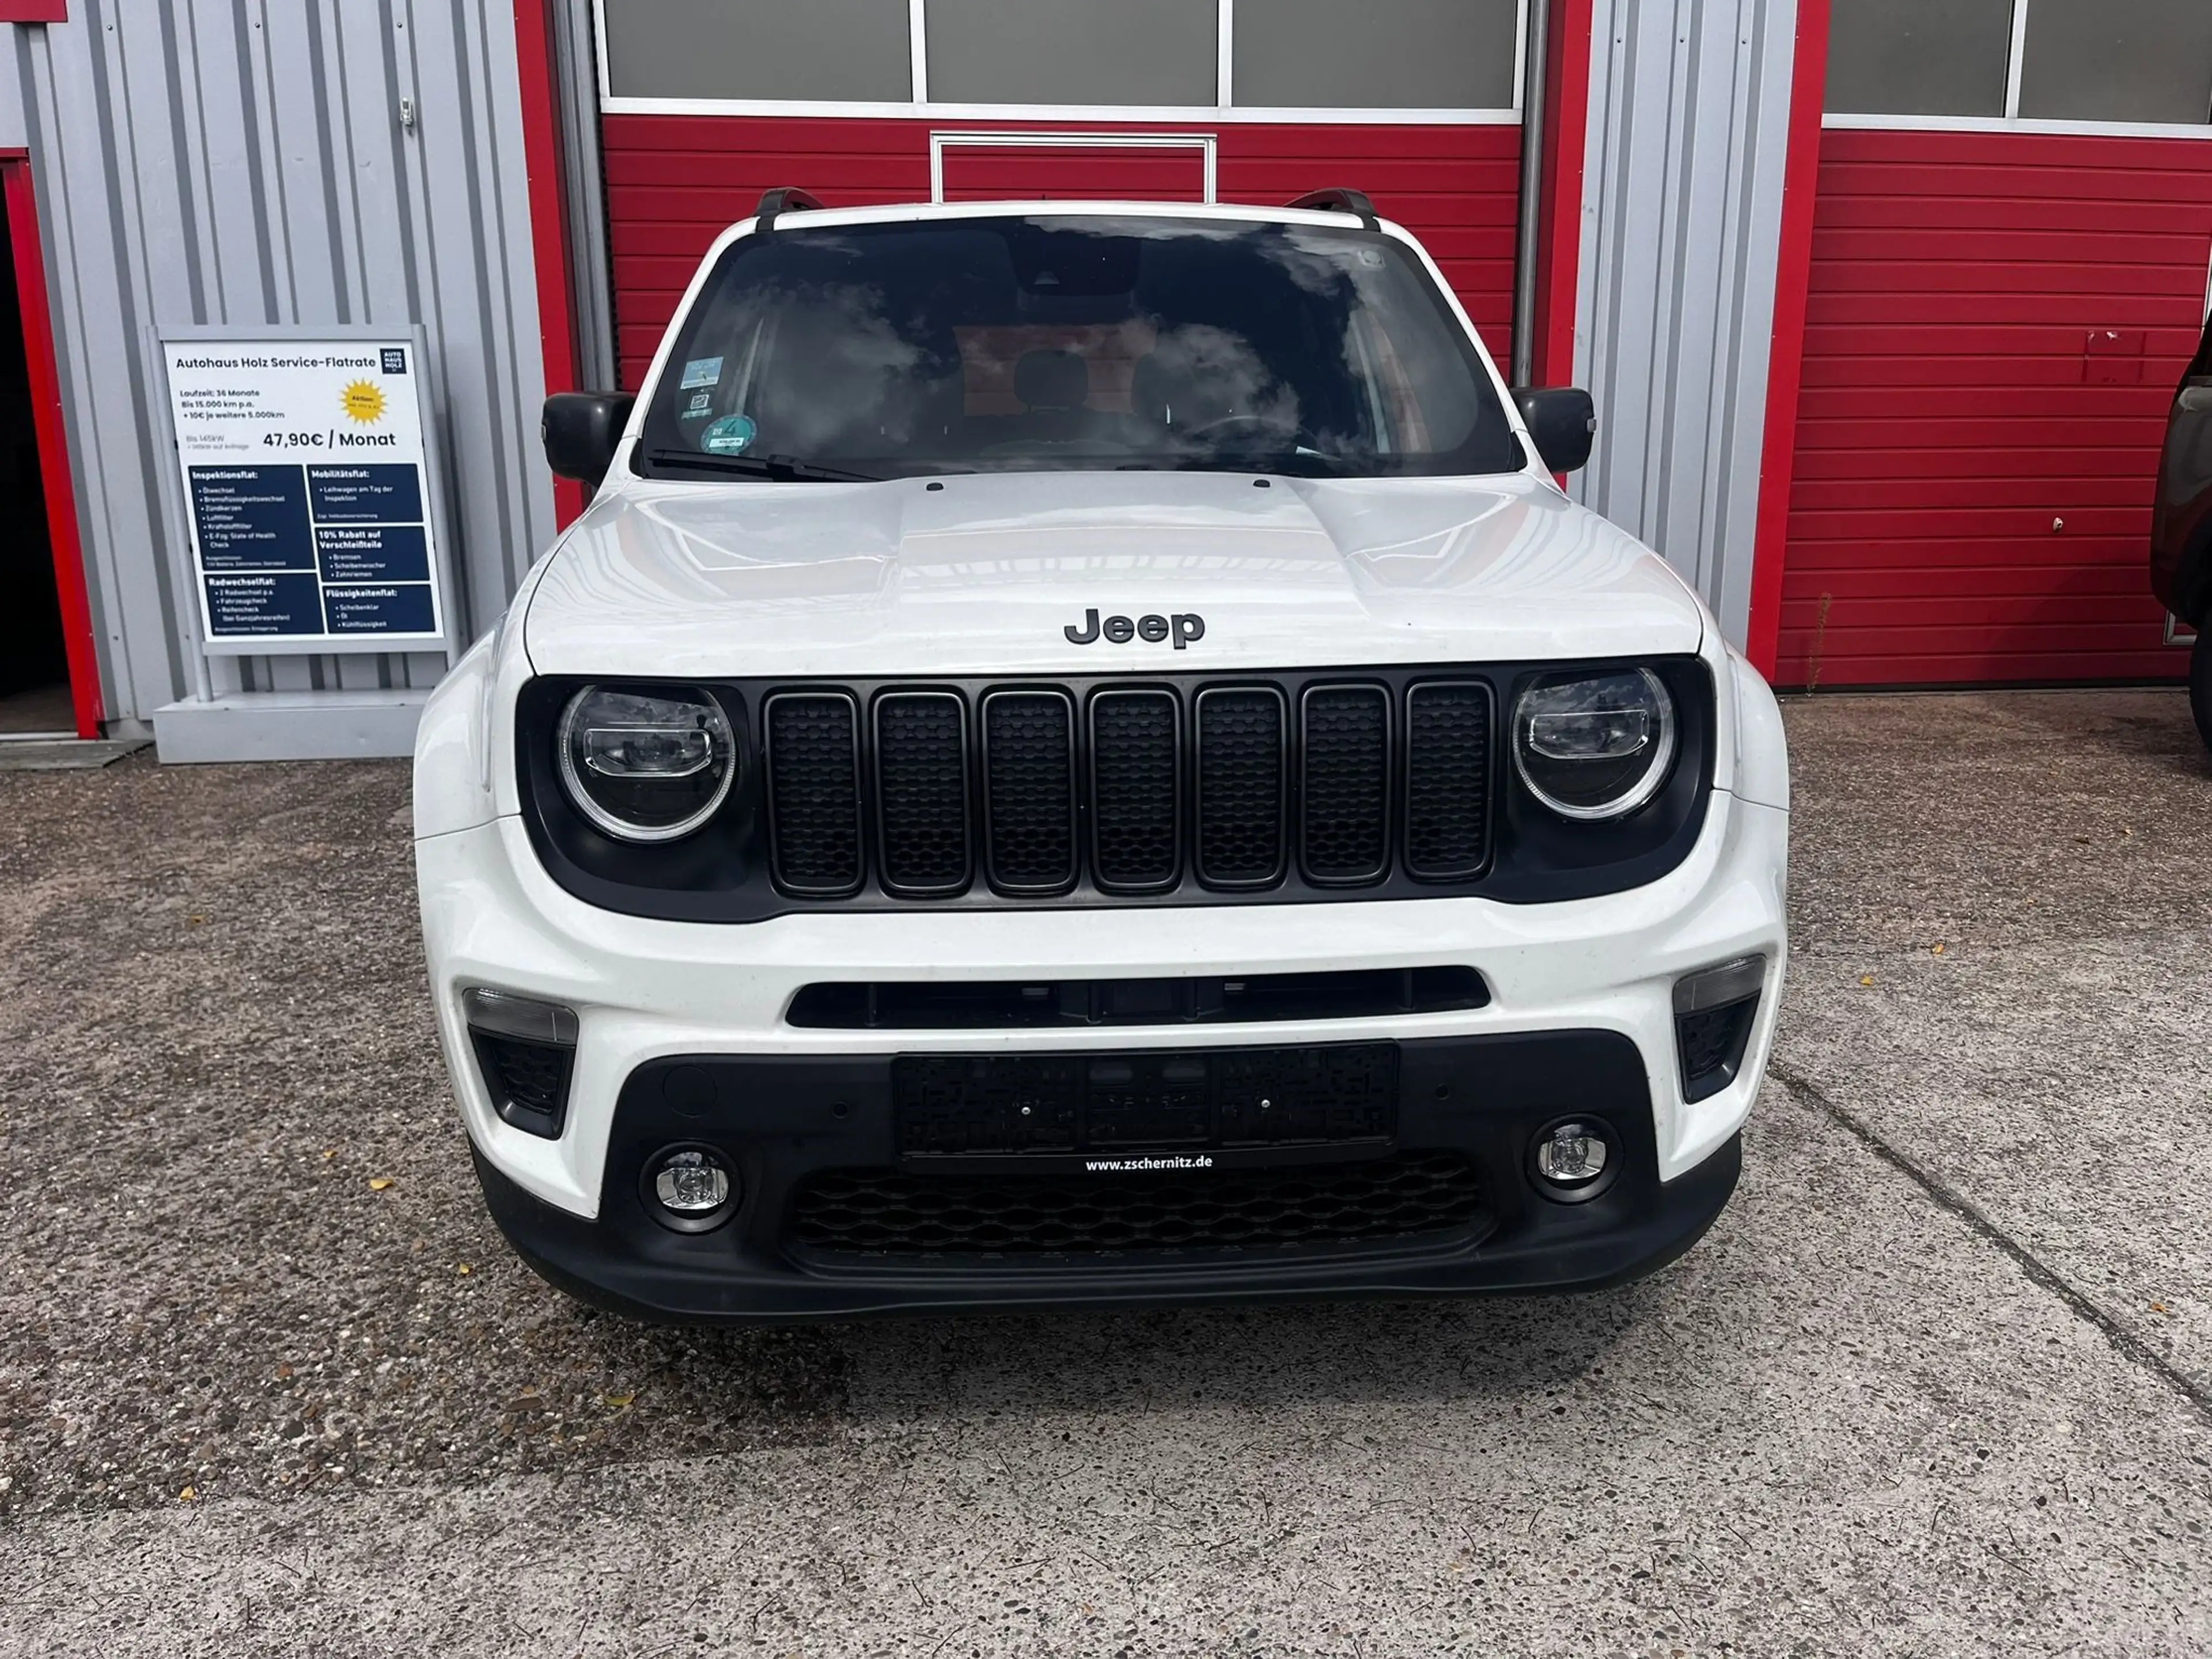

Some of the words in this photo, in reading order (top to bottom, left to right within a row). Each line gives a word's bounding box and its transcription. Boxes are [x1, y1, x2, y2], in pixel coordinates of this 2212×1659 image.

[176, 358, 238, 368] Autohaus
[241, 358, 268, 368] Holz
[271, 357, 376, 368] Service-Flatrate
[180, 389, 214, 397] Laufzeit:
[217, 389, 226, 397] 36
[228, 389, 260, 397] Monate
[206, 411, 214, 421] je
[724, 419, 737, 437] 4
[263, 433, 324, 448] 47,90€
[328, 429, 334, 449] /
[339, 433, 396, 446] Monat
[192, 471, 259, 480] Inspektionsflat:
[311, 470, 370, 478] Mobilitätsflat:
[339, 531, 366, 539] Rabatt
[320, 540, 382, 549] Verschleißteile
[209, 578, 276, 586] Radwechselflat:
[326, 589, 397, 599] Flüssigkeitenflat:
[1064, 608, 1205, 650] Jeep
[1086, 1155, 1213, 1171] www.zschernitz.de
